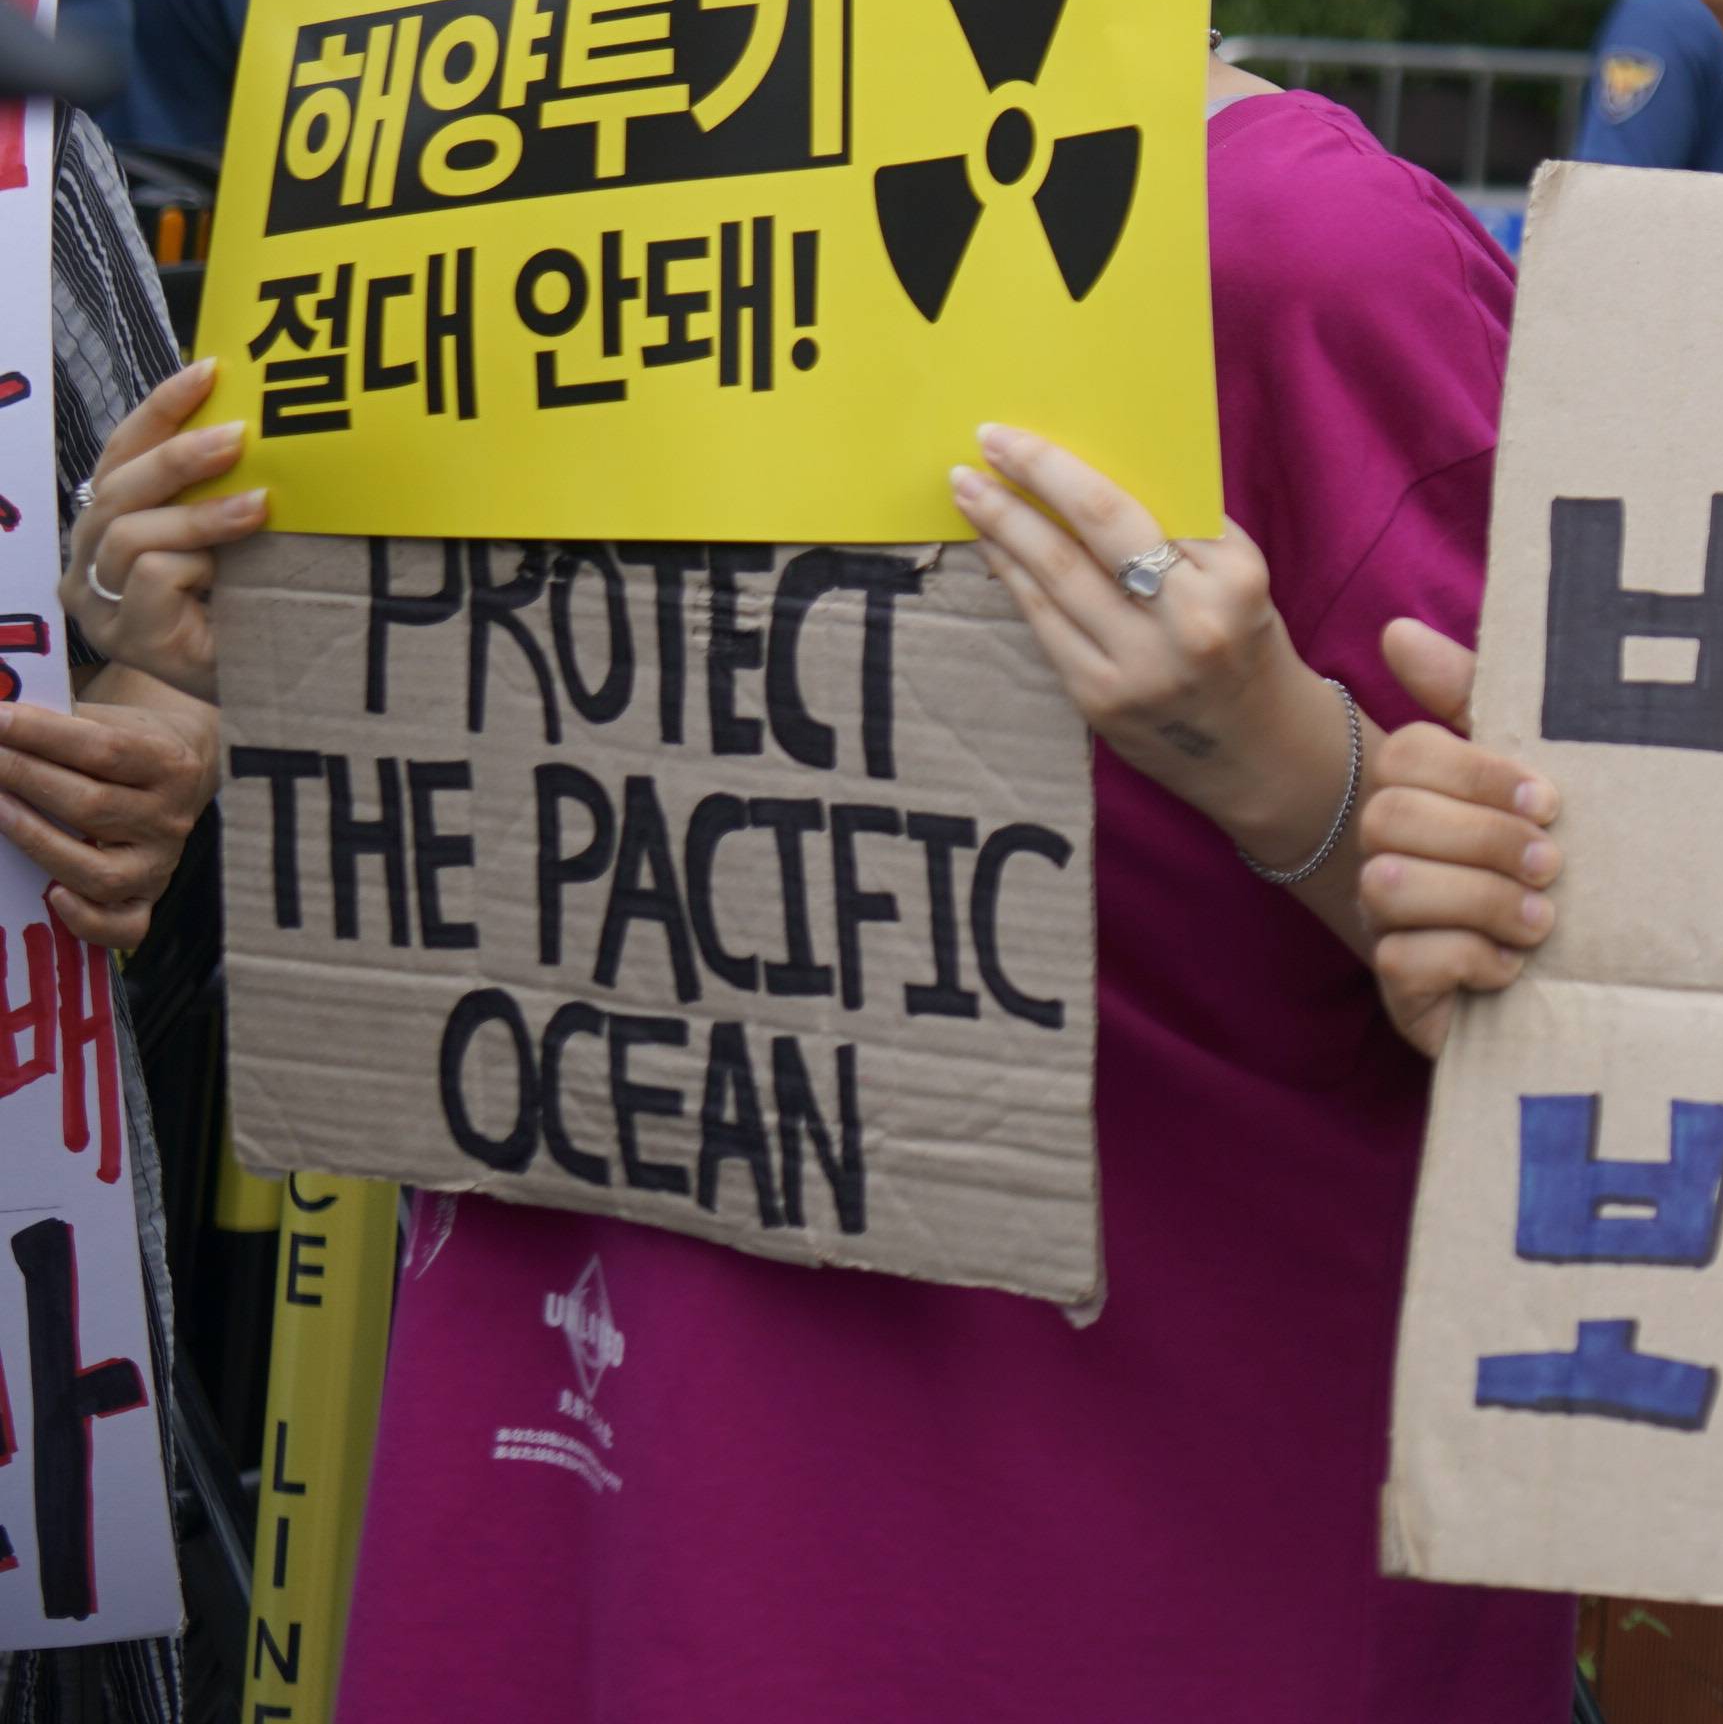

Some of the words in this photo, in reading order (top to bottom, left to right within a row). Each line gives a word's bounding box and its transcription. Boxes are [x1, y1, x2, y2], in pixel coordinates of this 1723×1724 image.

[246, 246, 479, 439] 절대
[513, 214, 820, 410] 안돼!
[366, 537, 923, 780] PROTECT
[230, 745, 480, 950] THE
[534, 762, 1074, 1030] PACIFIC
[438, 987, 867, 1235] OCEAN
[254, 1420, 306, 1724] LIN
